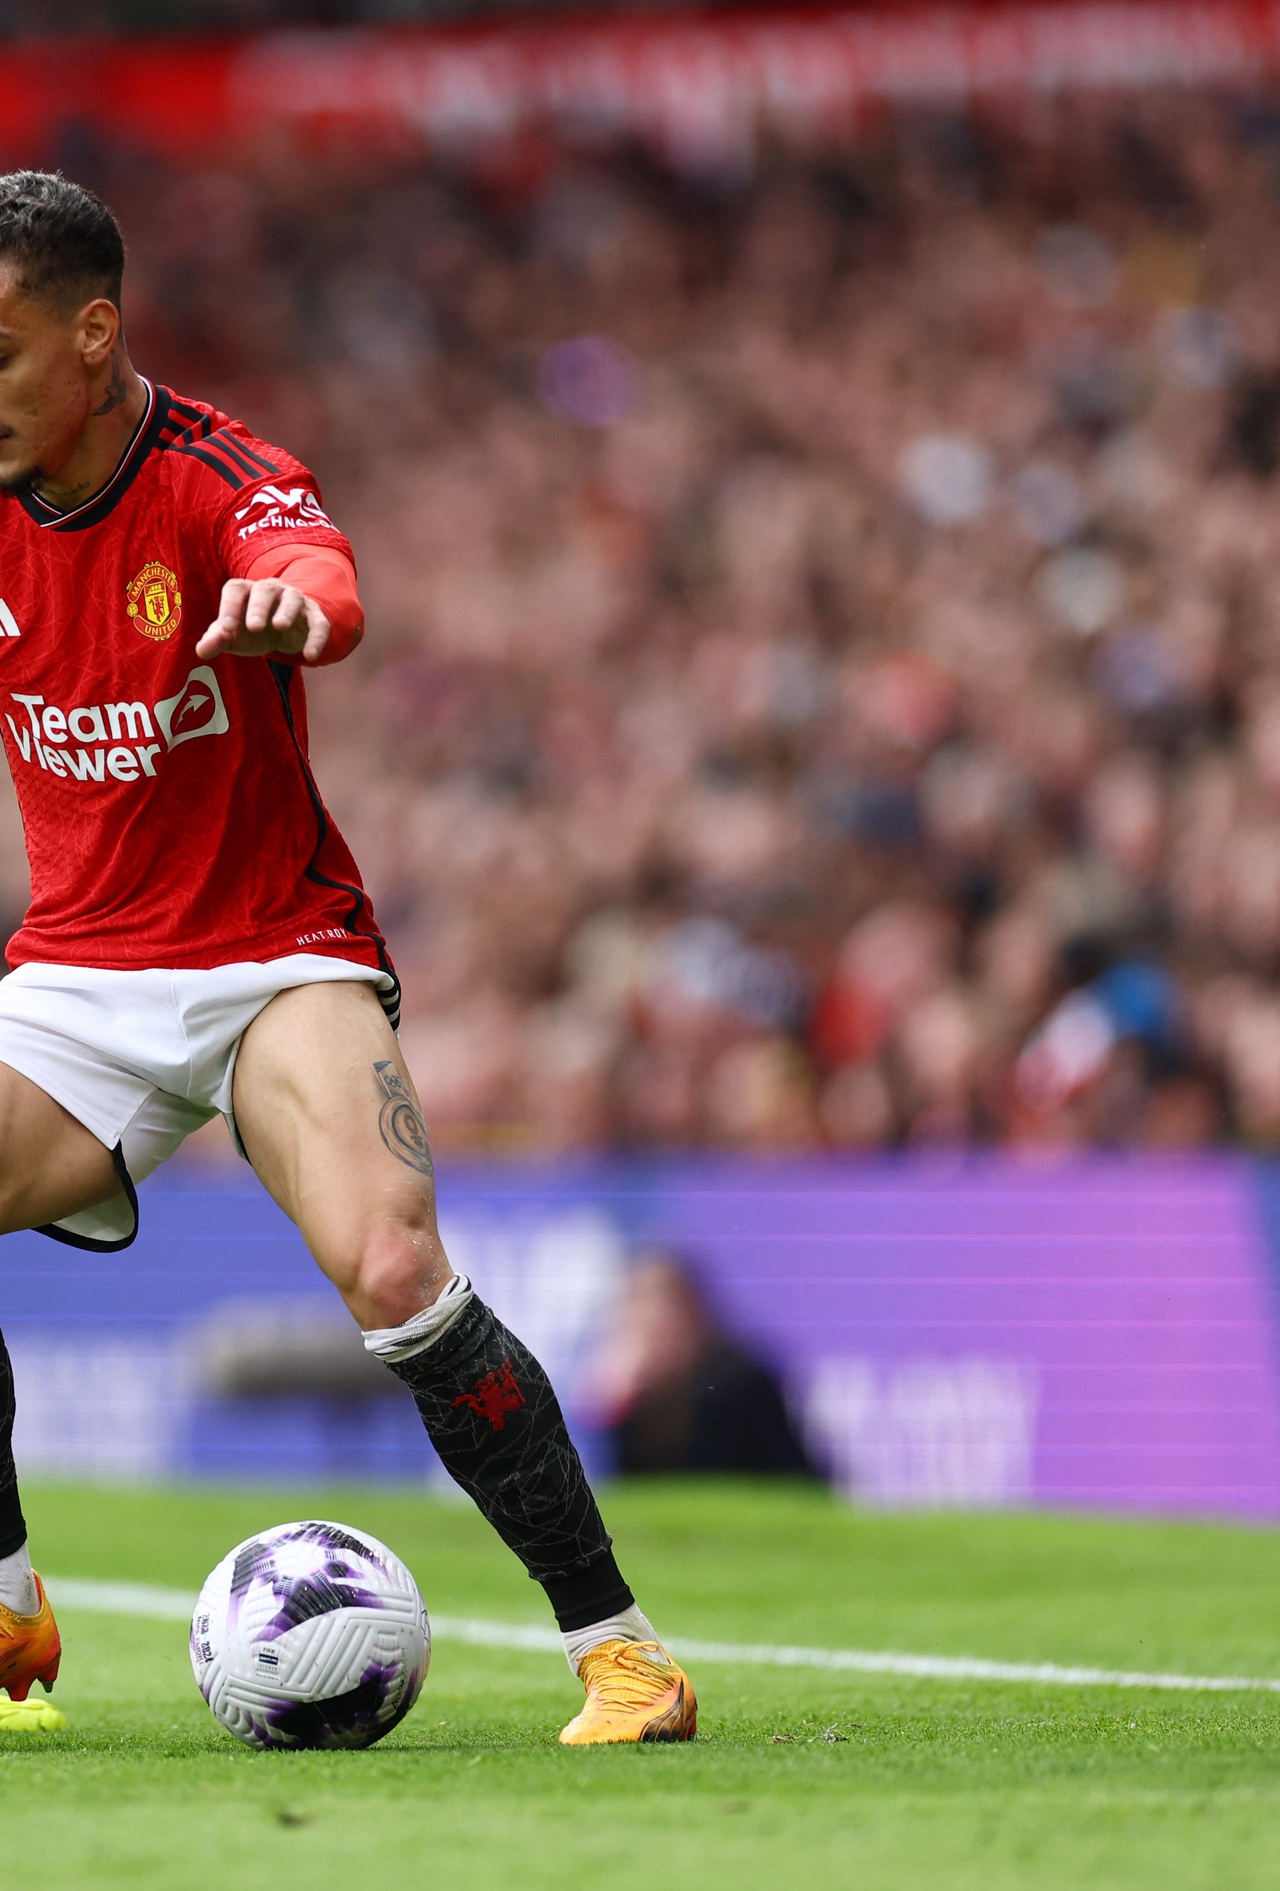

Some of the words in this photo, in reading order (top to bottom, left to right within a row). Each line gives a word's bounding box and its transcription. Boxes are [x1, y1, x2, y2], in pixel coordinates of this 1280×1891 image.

[238, 515, 341, 541] TECHNOLO
[131, 567, 176, 597] MANCHESTER
[144, 619, 177, 635] UNITED
[10, 693, 155, 743] Team
[5, 713, 161, 782] Viewer
[296, 928, 348, 946] HEAT.RDY
